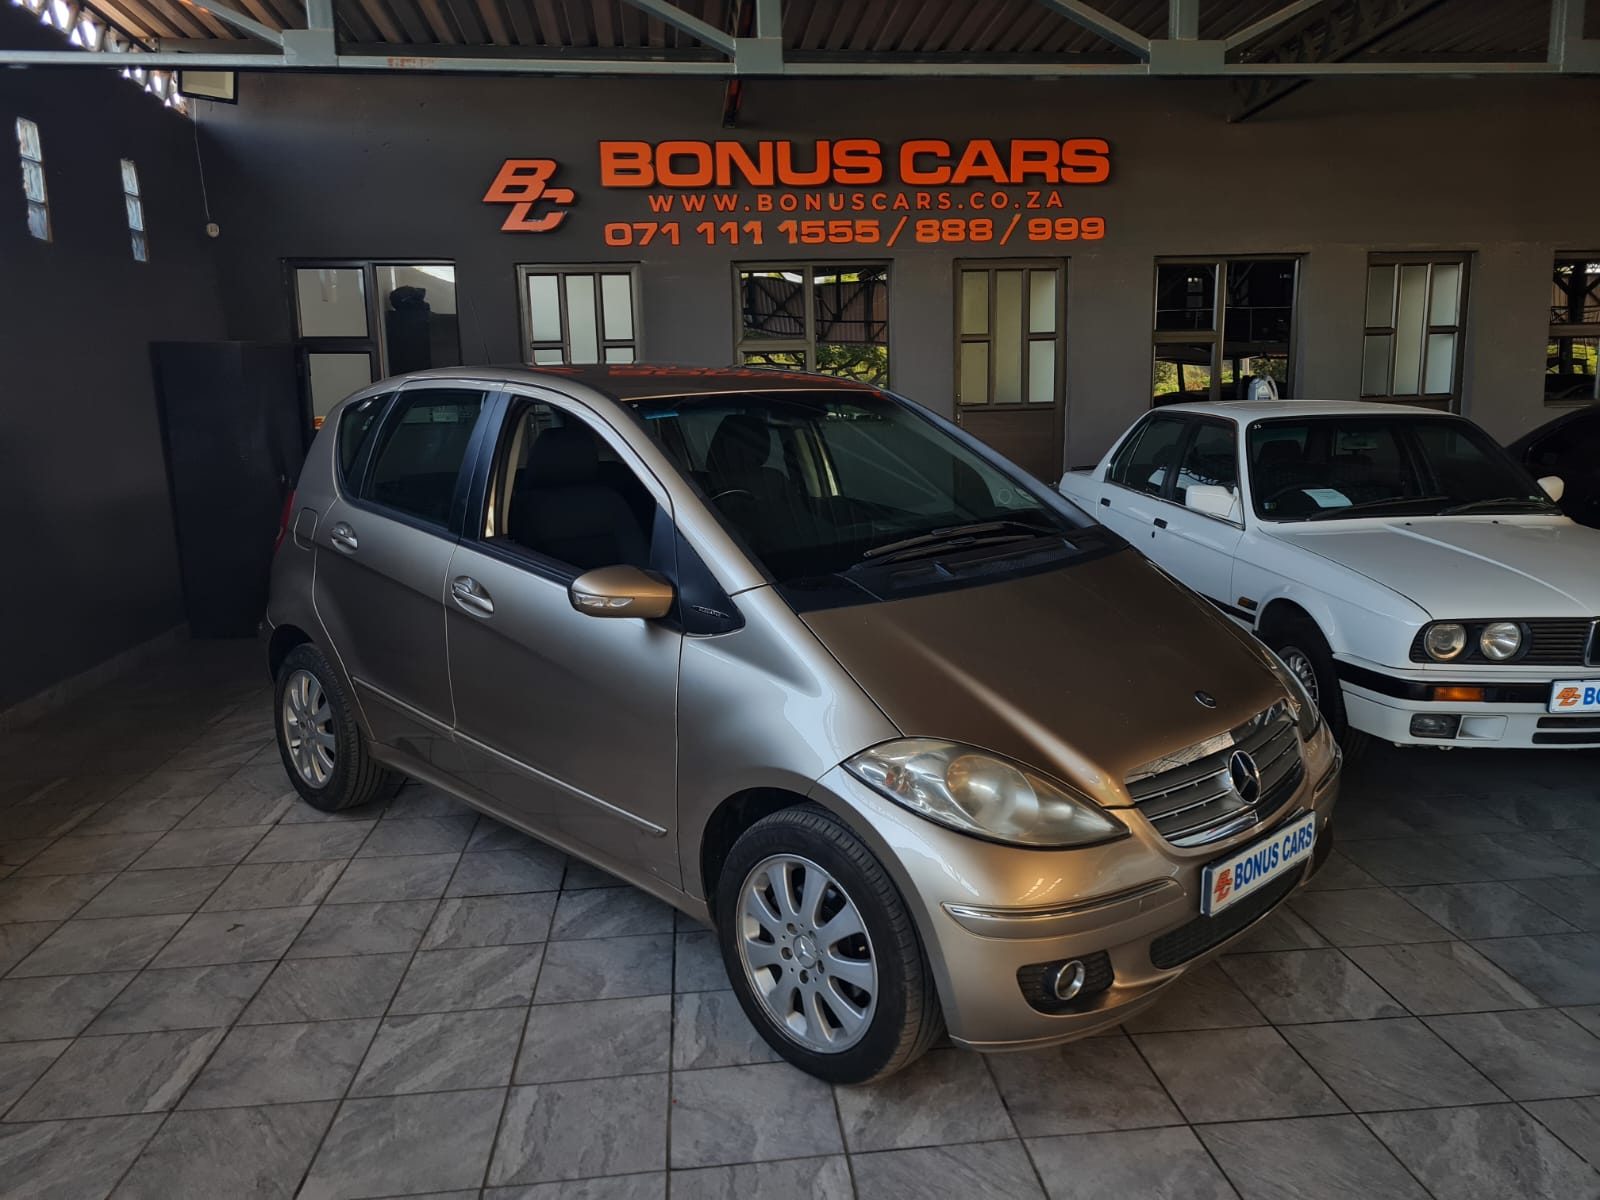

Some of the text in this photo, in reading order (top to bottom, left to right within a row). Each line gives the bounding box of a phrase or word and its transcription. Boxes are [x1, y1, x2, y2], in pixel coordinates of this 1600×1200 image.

[599, 138, 1110, 188] BONUS CARS
[482, 159, 575, 232] BC
[648, 191, 1064, 213] WWW.BONUSCARS.CO.ZA
[604, 222, 680, 246] 071
[696, 220, 763, 245] 111
[777, 219, 880, 244] 1555
[915, 218, 993, 244] 888
[1027, 216, 1105, 242] 999
[1583, 686, 1600, 705] B
[1234, 842, 1279, 892] BONUS
[1282, 822, 1313, 862] CARS
